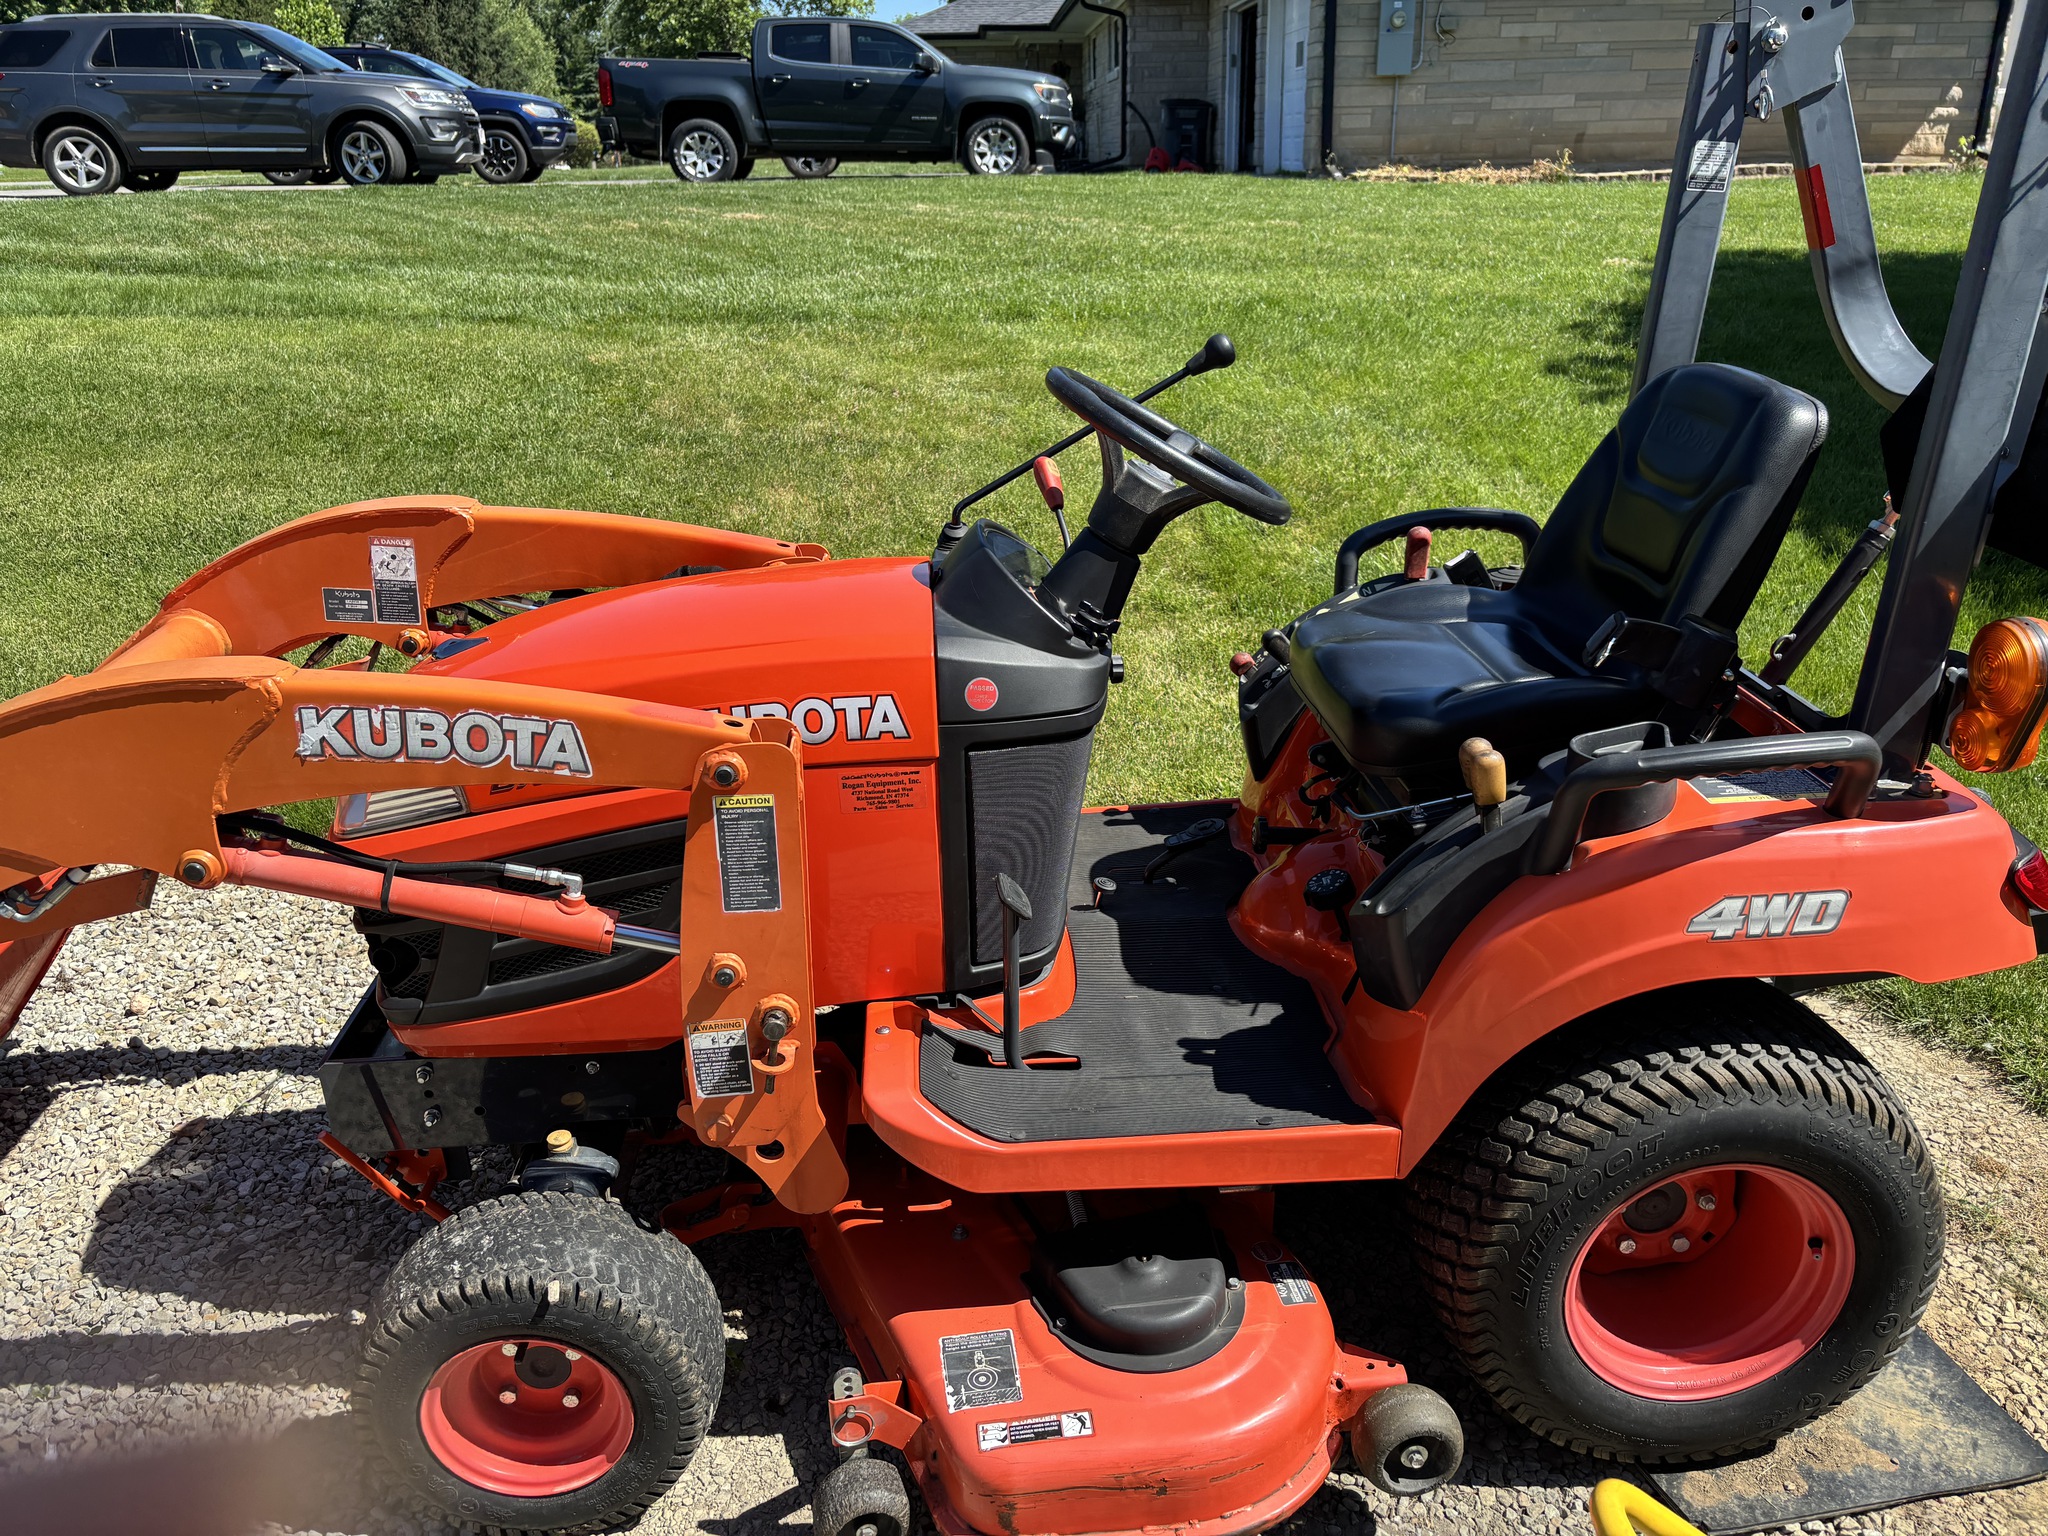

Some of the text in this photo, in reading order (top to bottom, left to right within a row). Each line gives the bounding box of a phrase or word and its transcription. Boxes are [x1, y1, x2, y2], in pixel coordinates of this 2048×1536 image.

[297, 705, 593, 775] KUBOTA
[702, 694, 911, 744] OTA
[728, 798, 770, 806] CAUTION
[842, 782, 864, 790] Rogan
[866, 779, 906, 788] Equipment,
[1686, 890, 1850, 940] 4WD
[700, 1022, 741, 1031] WARNING
[1510, 1129, 1666, 1309] LITEFOOT
[1886, 1182, 1909, 1221] SERVICE
[1537, 1261, 1560, 1320] SERVICE
